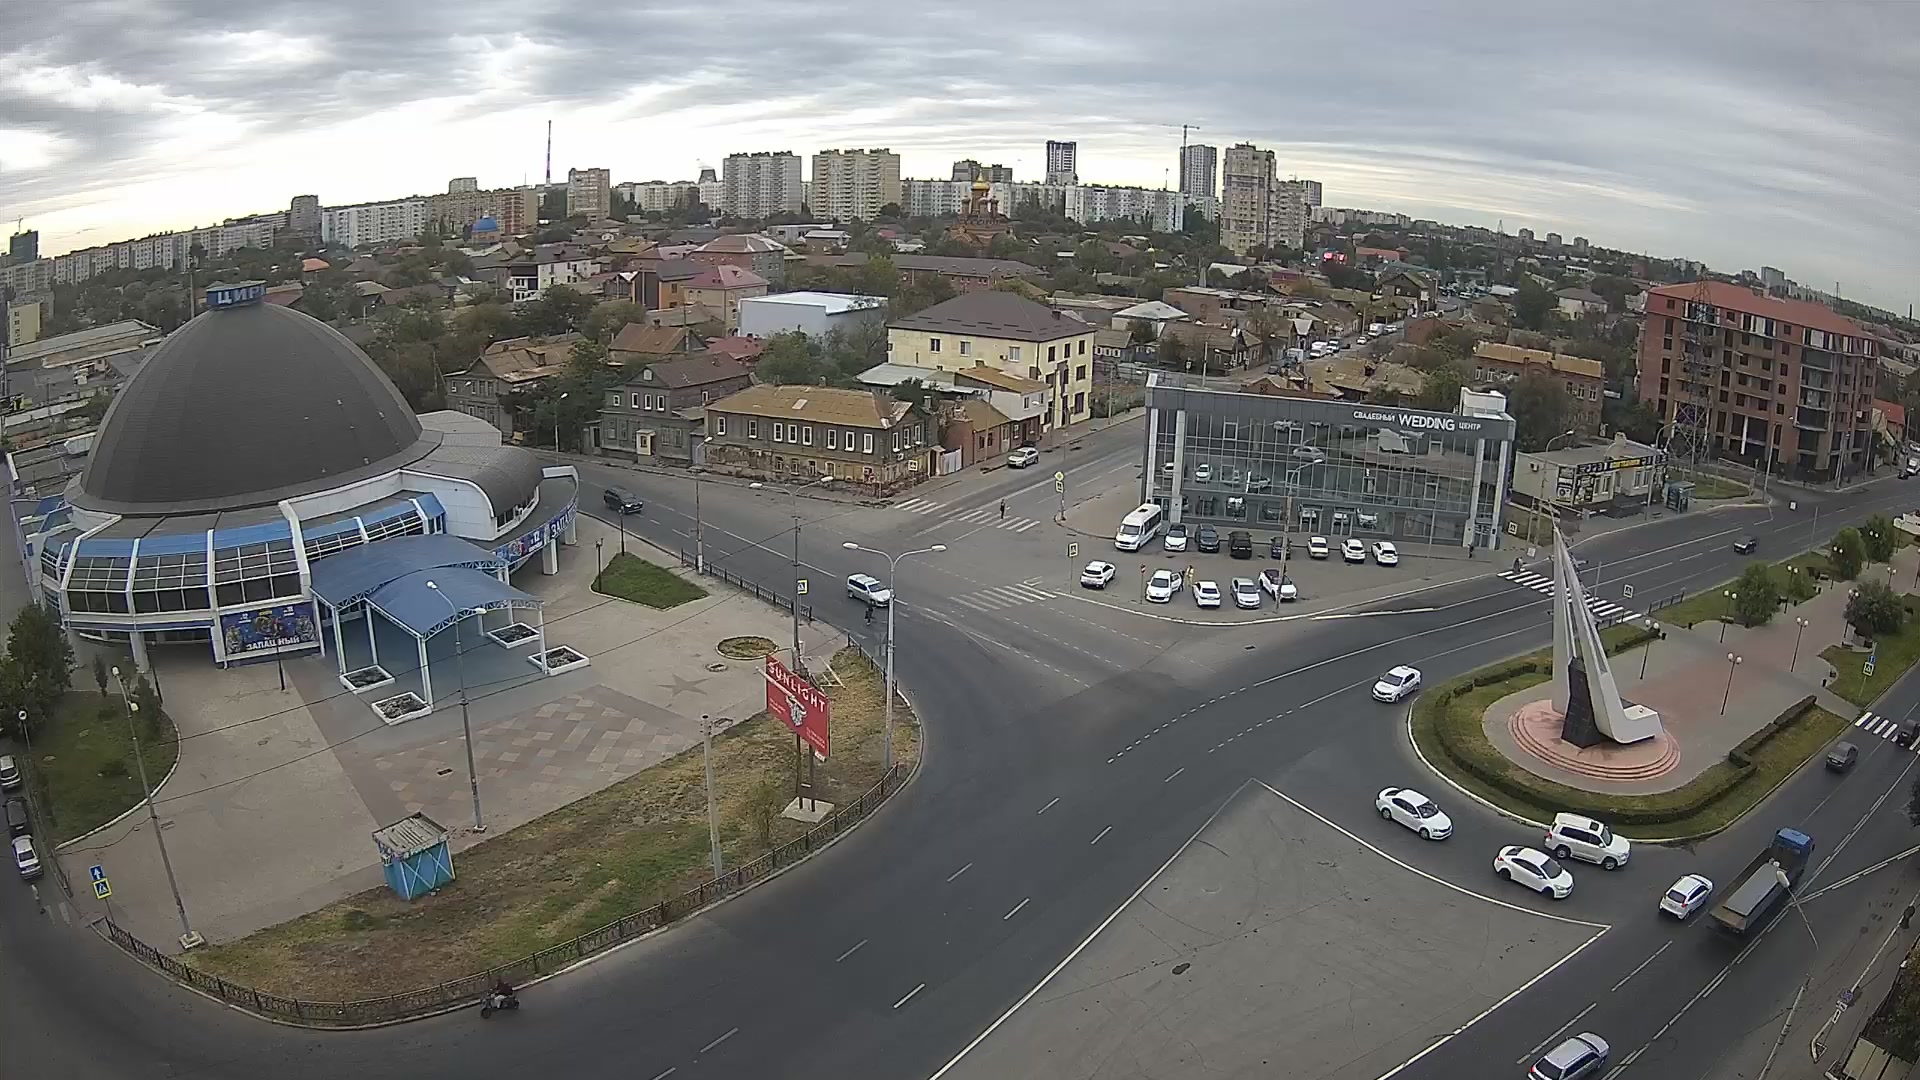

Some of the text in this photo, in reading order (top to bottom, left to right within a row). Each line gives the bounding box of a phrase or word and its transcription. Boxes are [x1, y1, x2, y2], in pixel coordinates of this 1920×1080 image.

[1353, 411, 1482, 431] СВАДЕБНЫЙ WEDDING ЦЕНТР
[767, 661, 826, 713] SUNLIGHT
